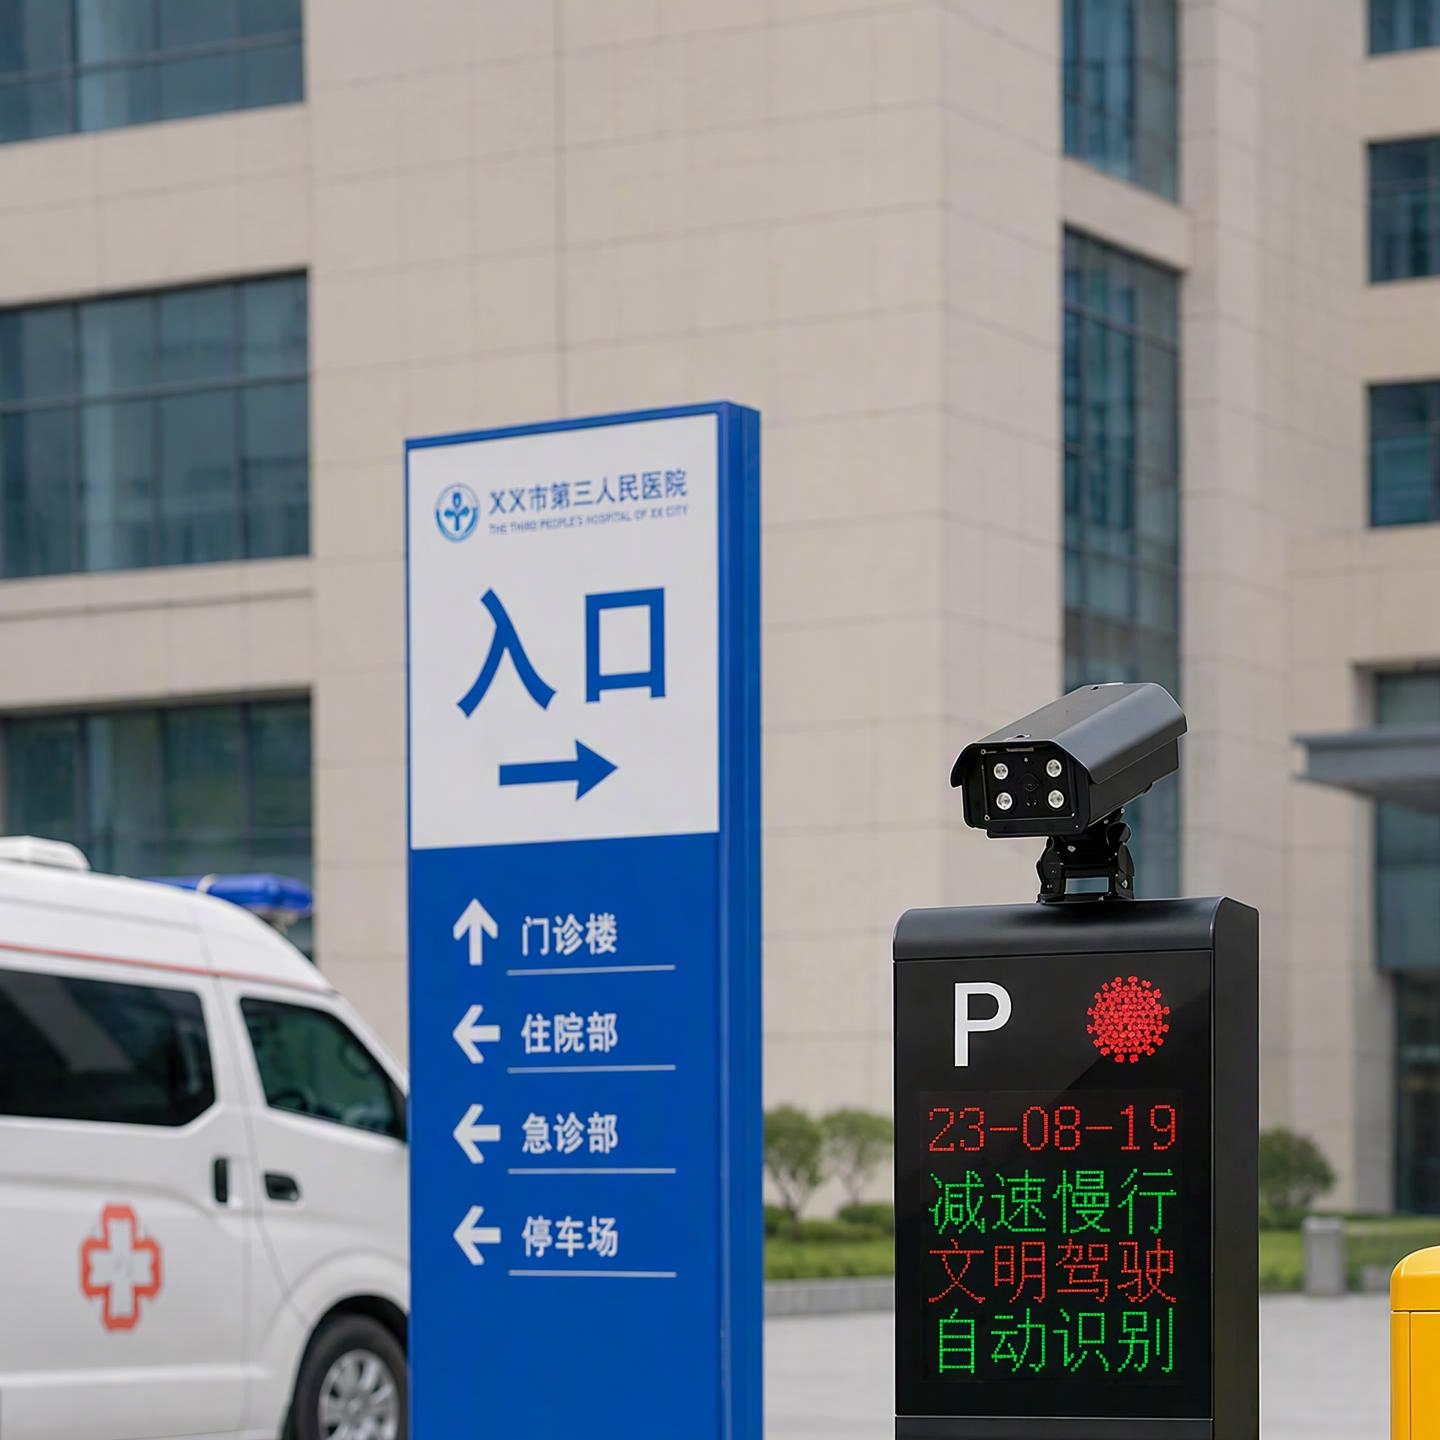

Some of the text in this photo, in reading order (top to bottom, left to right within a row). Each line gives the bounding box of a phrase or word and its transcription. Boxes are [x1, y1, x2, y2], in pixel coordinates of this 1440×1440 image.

[488, 522, 508, 535] THE
[511, 519, 537, 533] THIRD
[540, 516, 583, 530] PEOPLE'S
[586, 511, 632, 525] HOSPITAL
[634, 508, 647, 520] OF
[665, 504, 688, 517] CITY
[457, 587, 666, 718] 入口
[522, 912, 618, 956] 门诊楼
[521, 1011, 618, 1054] 住院部
[954, 981, 1012, 1067] P
[522, 1112, 618, 1154] 急诊部
[928, 1104, 1177, 1152] 23-08-19
[928, 1168, 1177, 1235] 减速慢行
[521, 1215, 618, 1258] 停车场
[928, 1238, 1177, 1304] 文明驾驶
[938, 1307, 1174, 1374] 自动识别
